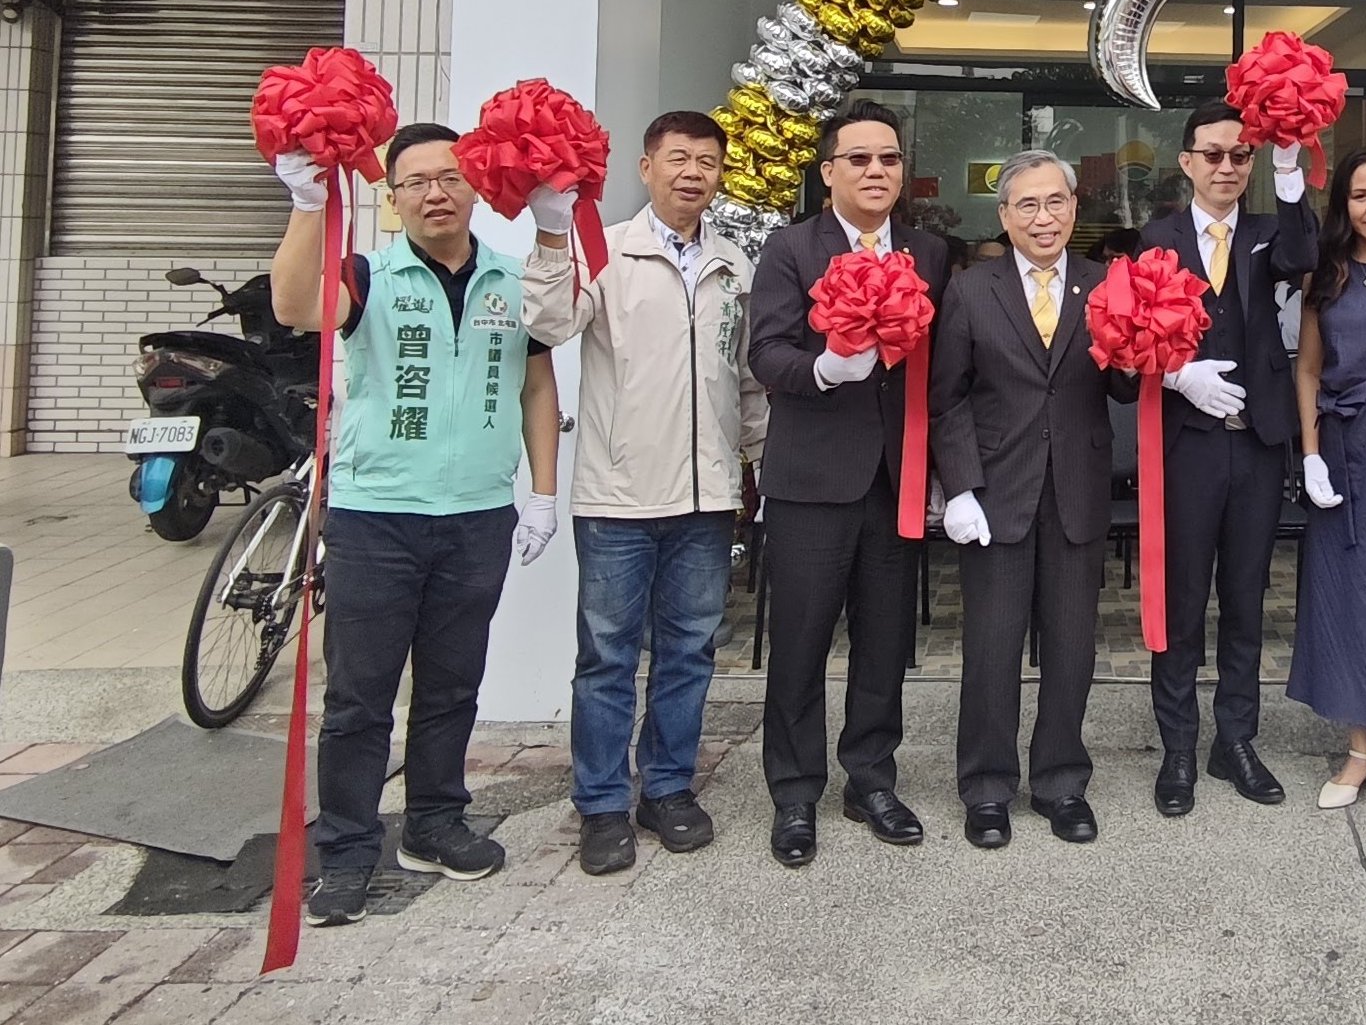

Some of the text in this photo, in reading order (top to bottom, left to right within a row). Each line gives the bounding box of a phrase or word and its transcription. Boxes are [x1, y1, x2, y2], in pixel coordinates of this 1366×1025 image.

[389, 324, 432, 441] 曾咨耀
[483, 332, 503, 429] 市議員候選人
